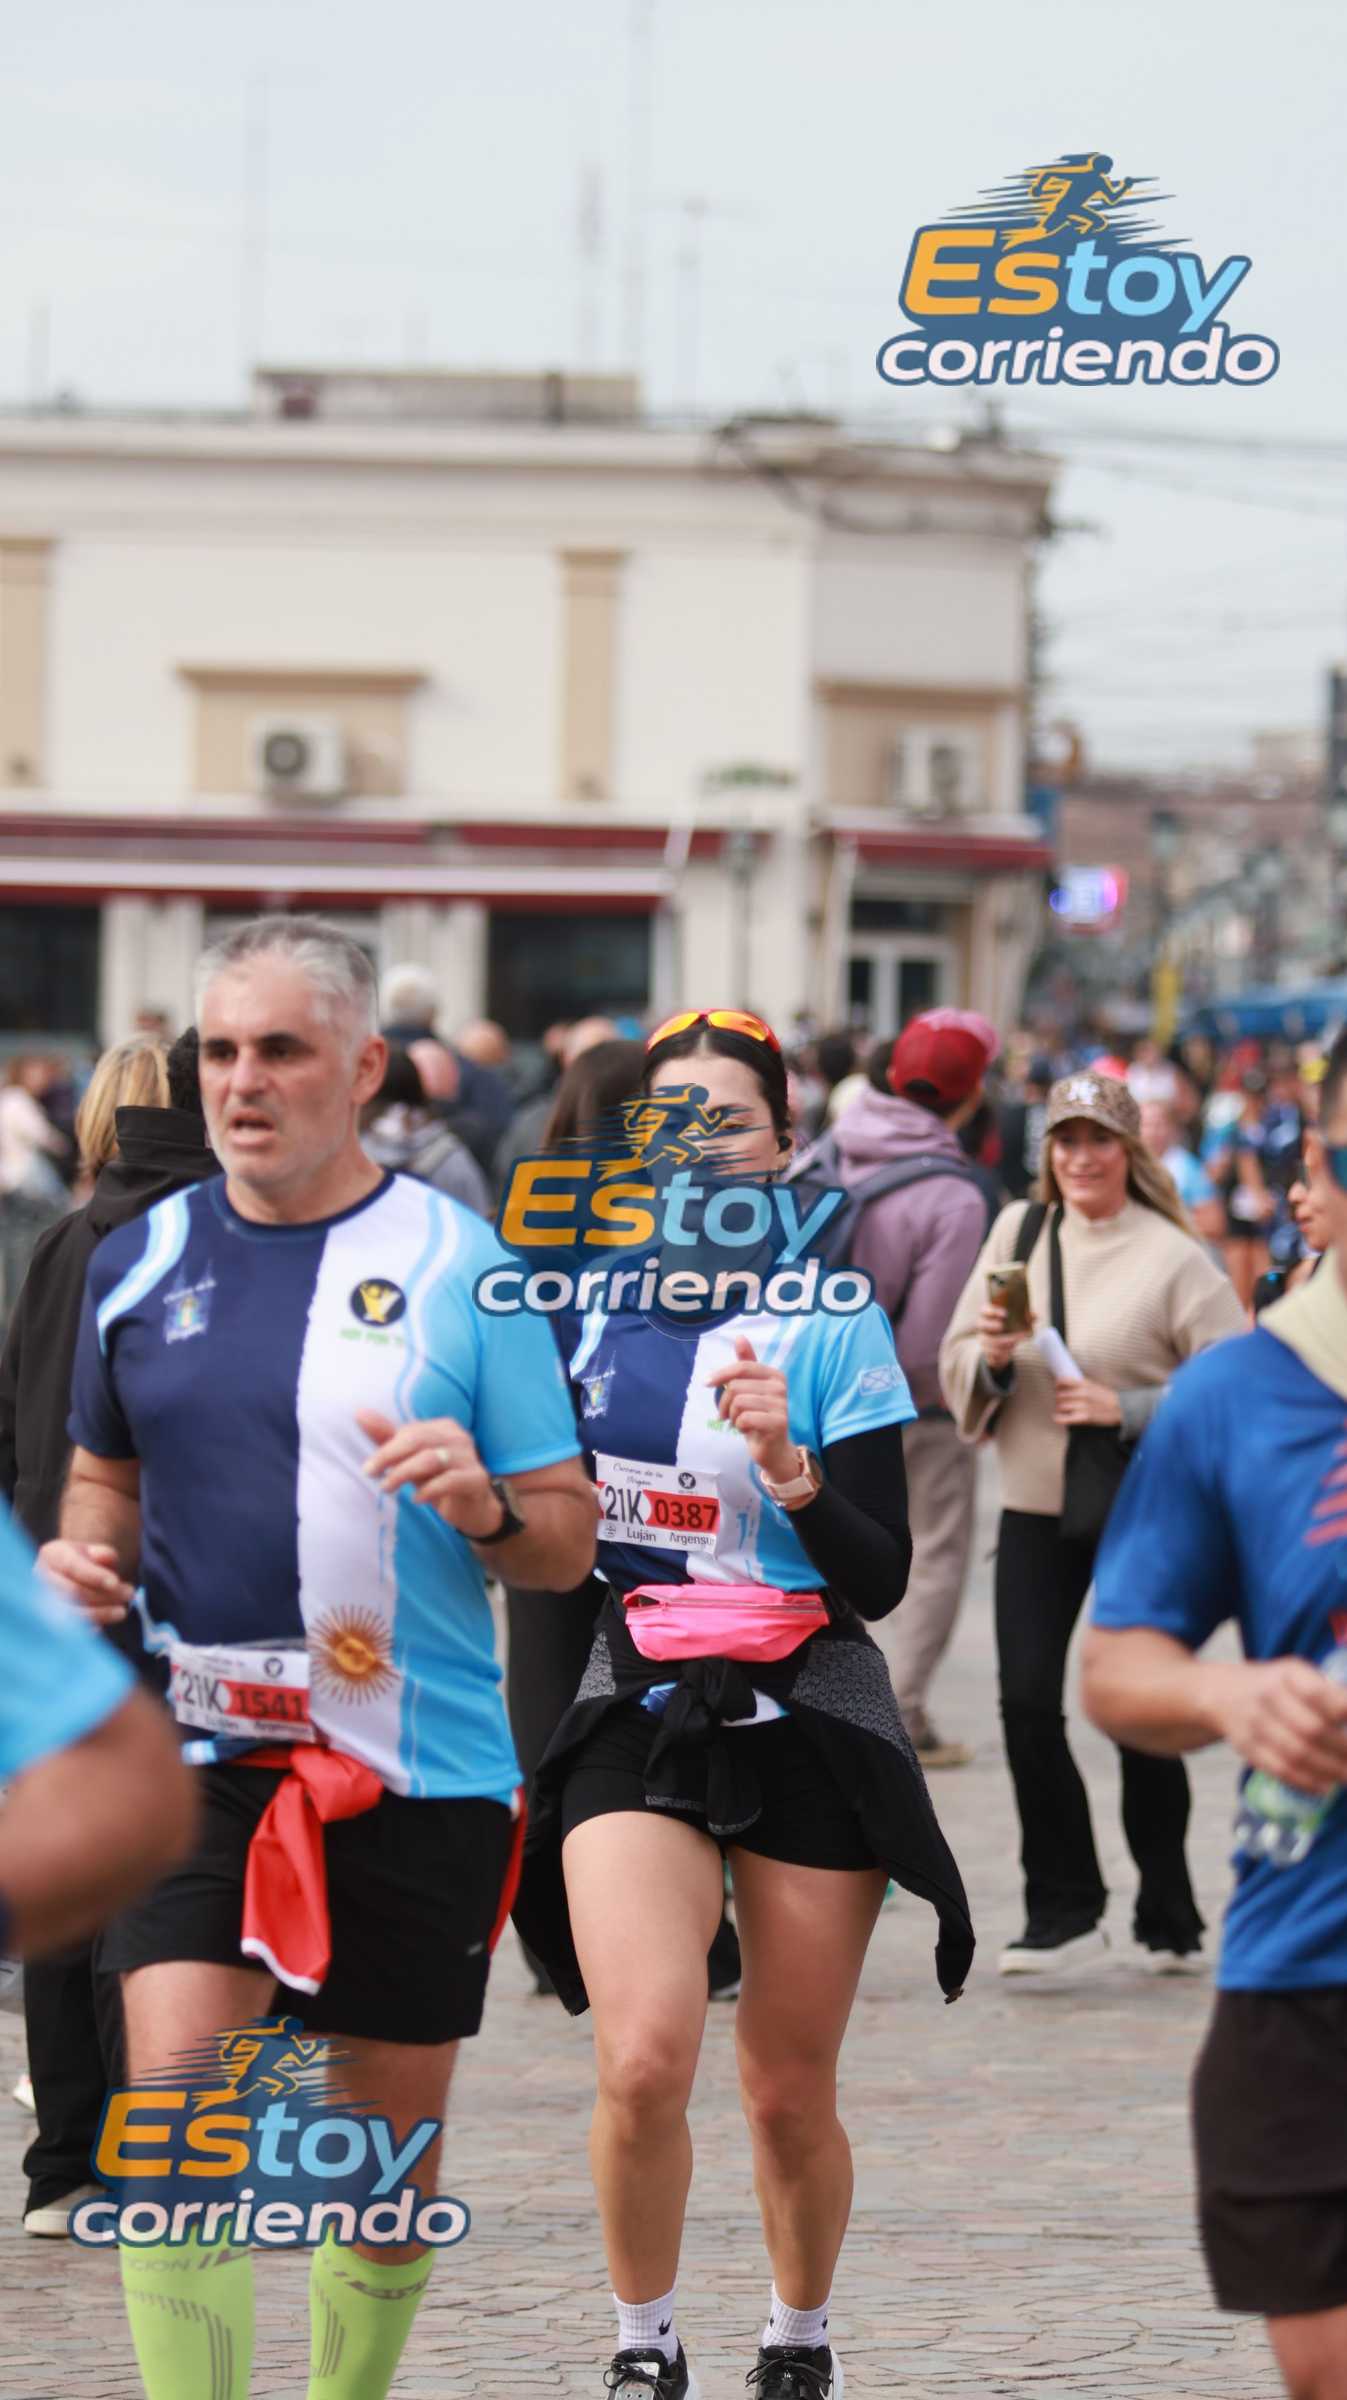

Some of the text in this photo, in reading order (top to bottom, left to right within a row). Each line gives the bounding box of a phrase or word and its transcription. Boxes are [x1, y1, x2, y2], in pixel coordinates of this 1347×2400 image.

[604, 1484, 718, 1530] 21K 0387
[626, 1526, 657, 1542] Luján
[181, 1669, 224, 1715] 21K
[235, 1687, 305, 1722] 1541
